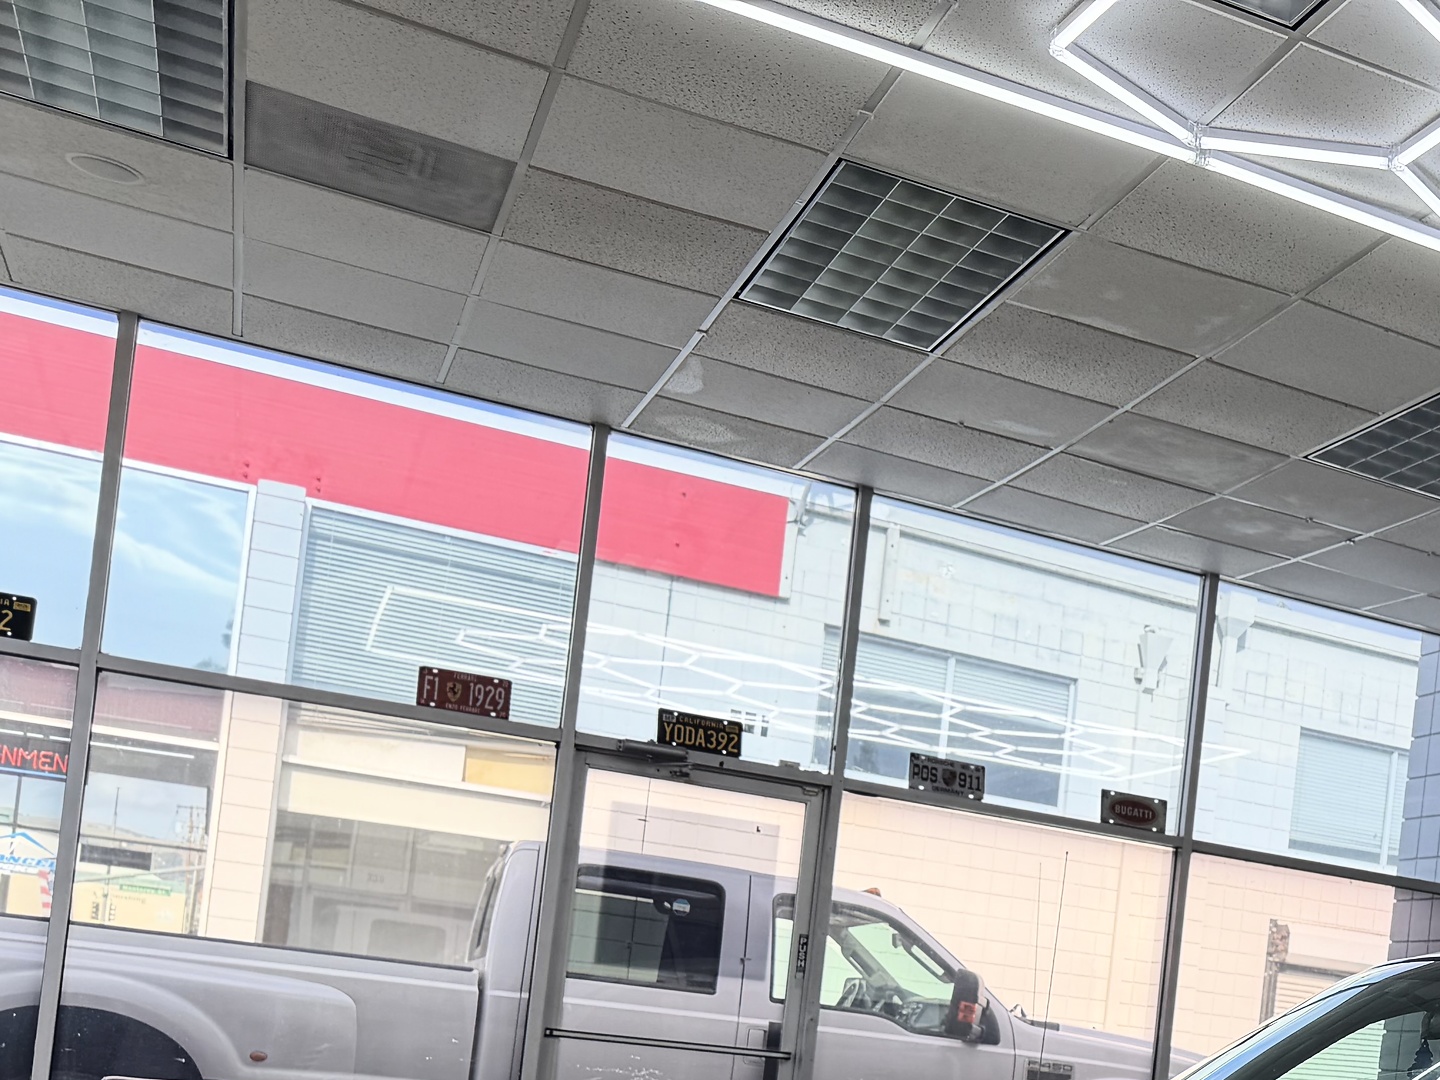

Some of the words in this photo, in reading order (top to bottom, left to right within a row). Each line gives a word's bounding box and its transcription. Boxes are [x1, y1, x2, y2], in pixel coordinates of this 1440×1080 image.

[424, 675, 439, 700] F1
[469, 682, 505, 710] 1929
[680, 716, 724, 729] CALIFORNIA
[664, 722, 738, 753] YODA392
[0, 744, 68, 773] NMEN
[912, 763, 938, 784] POS
[959, 772, 981, 792] 911
[931, 785, 964, 796] GERMANY
[1114, 804, 1153, 820] BUGATTI
[797, 937, 807, 968] PUSH
